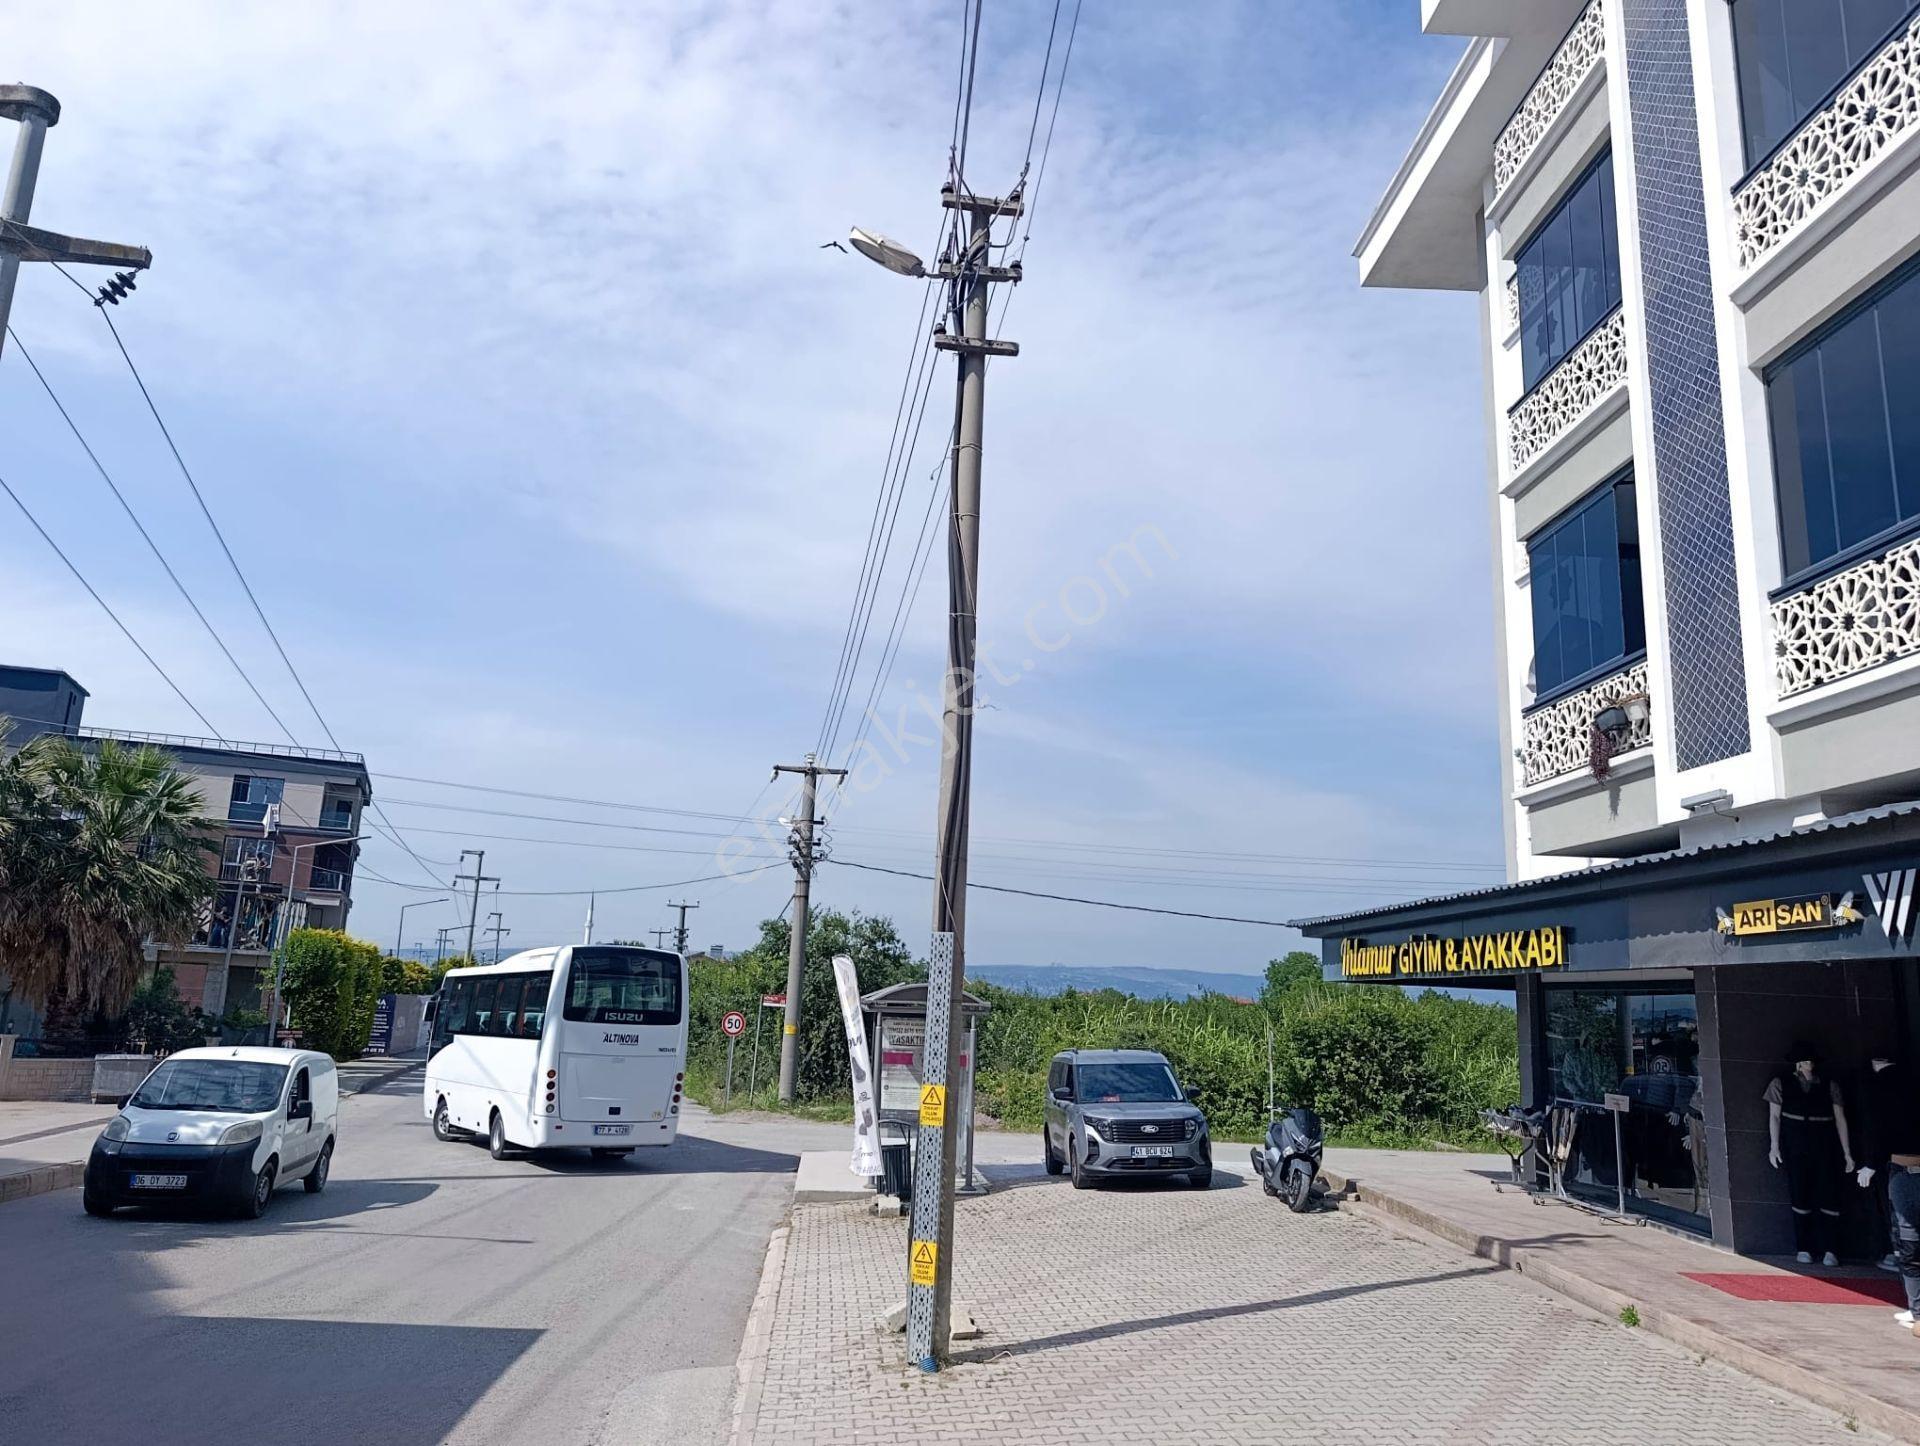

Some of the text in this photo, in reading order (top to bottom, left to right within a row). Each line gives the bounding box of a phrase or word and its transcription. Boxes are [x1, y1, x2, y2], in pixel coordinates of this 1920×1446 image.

[1398, 933, 1442, 974] GİYİM
[1445, 938, 1458, 972] &
[1461, 925, 1563, 971] AYAKKABI
[604, 1012, 643, 1022] ISUZU
[727, 1018, 741, 1029] 50
[603, 1034, 639, 1044] ALTINOVA
[135, 1175, 145, 1184] 06
[165, 1176, 186, 1185] 3723
